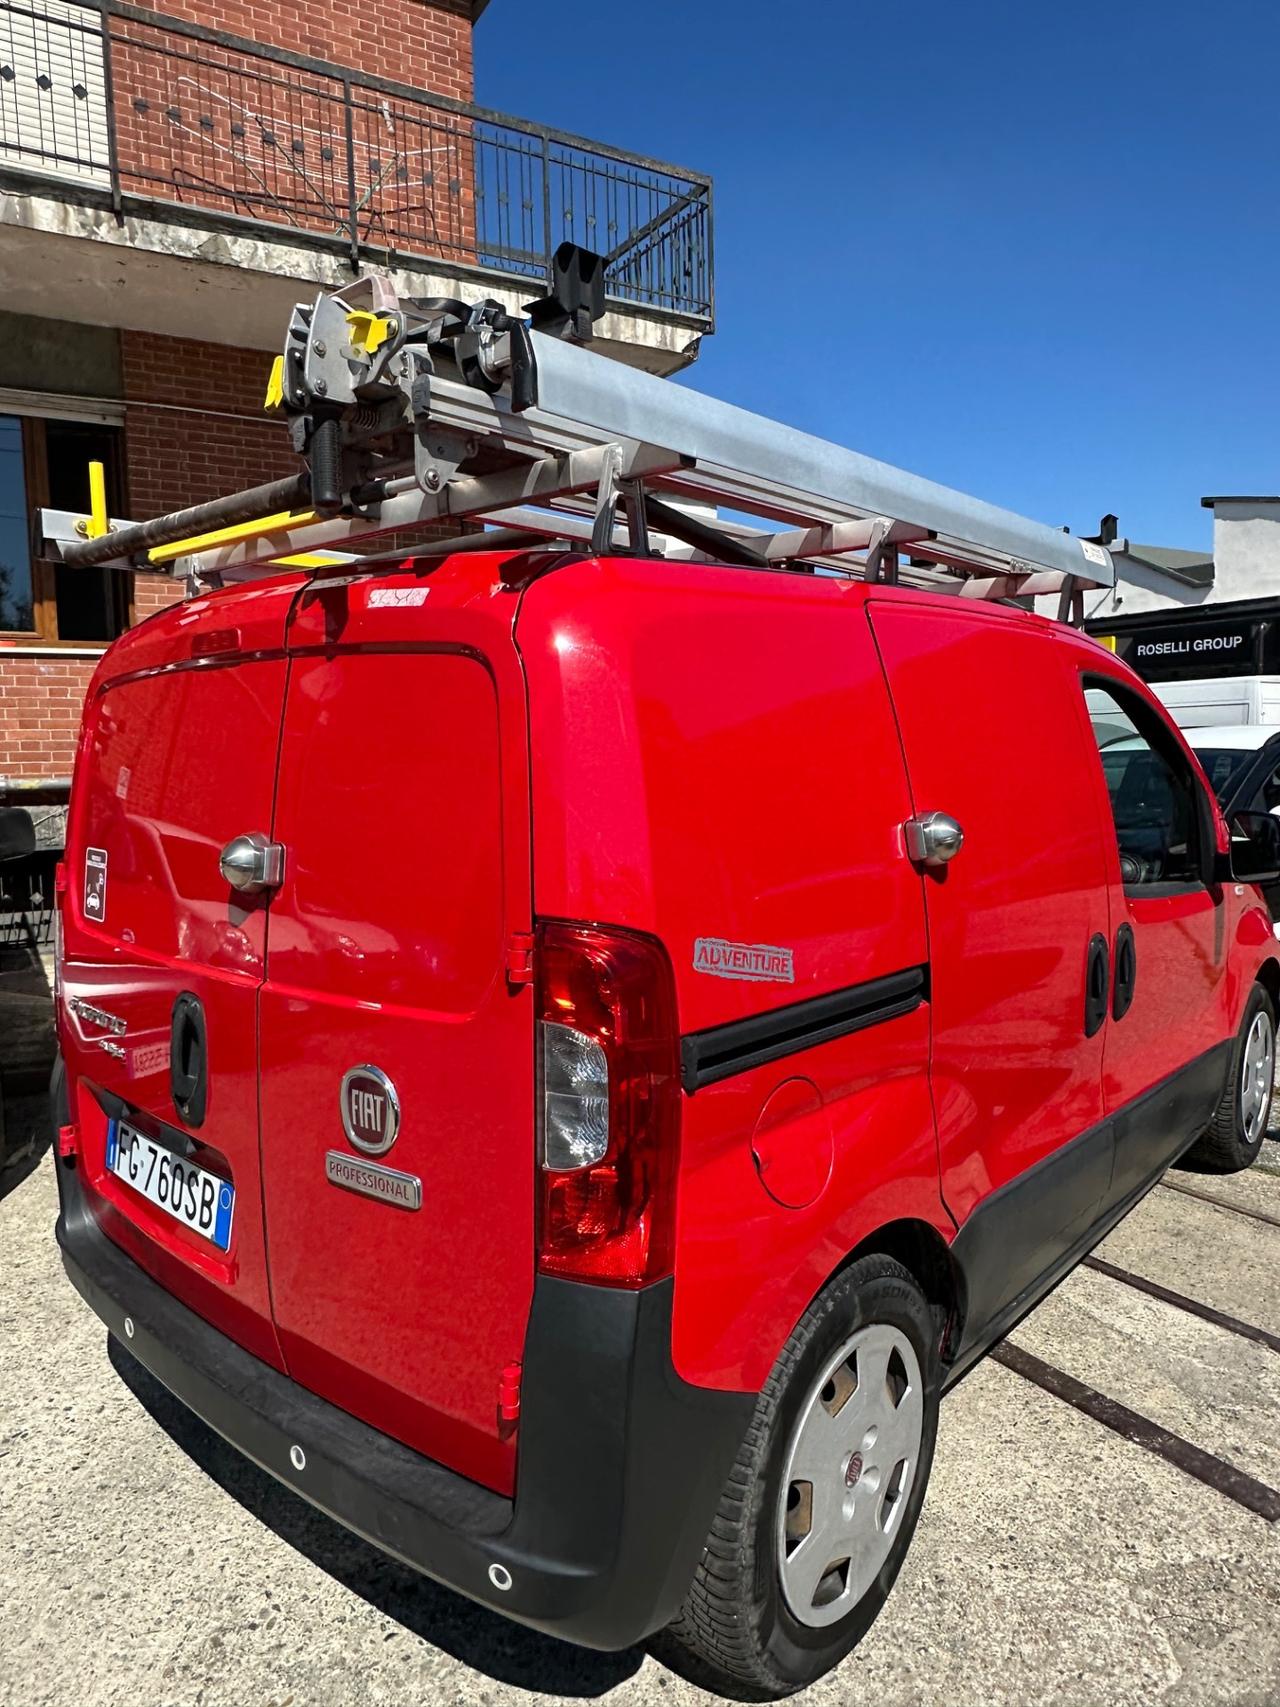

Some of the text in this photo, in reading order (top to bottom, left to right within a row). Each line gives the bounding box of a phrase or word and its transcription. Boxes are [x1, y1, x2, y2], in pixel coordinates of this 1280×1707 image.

[1137, 636, 1242, 656] ROSELLI GROUP
[697, 946, 790, 975] ADVENTURE
[351, 1088, 385, 1133] FIAT
[329, 1161, 410, 1201] PROFESSIONAL
